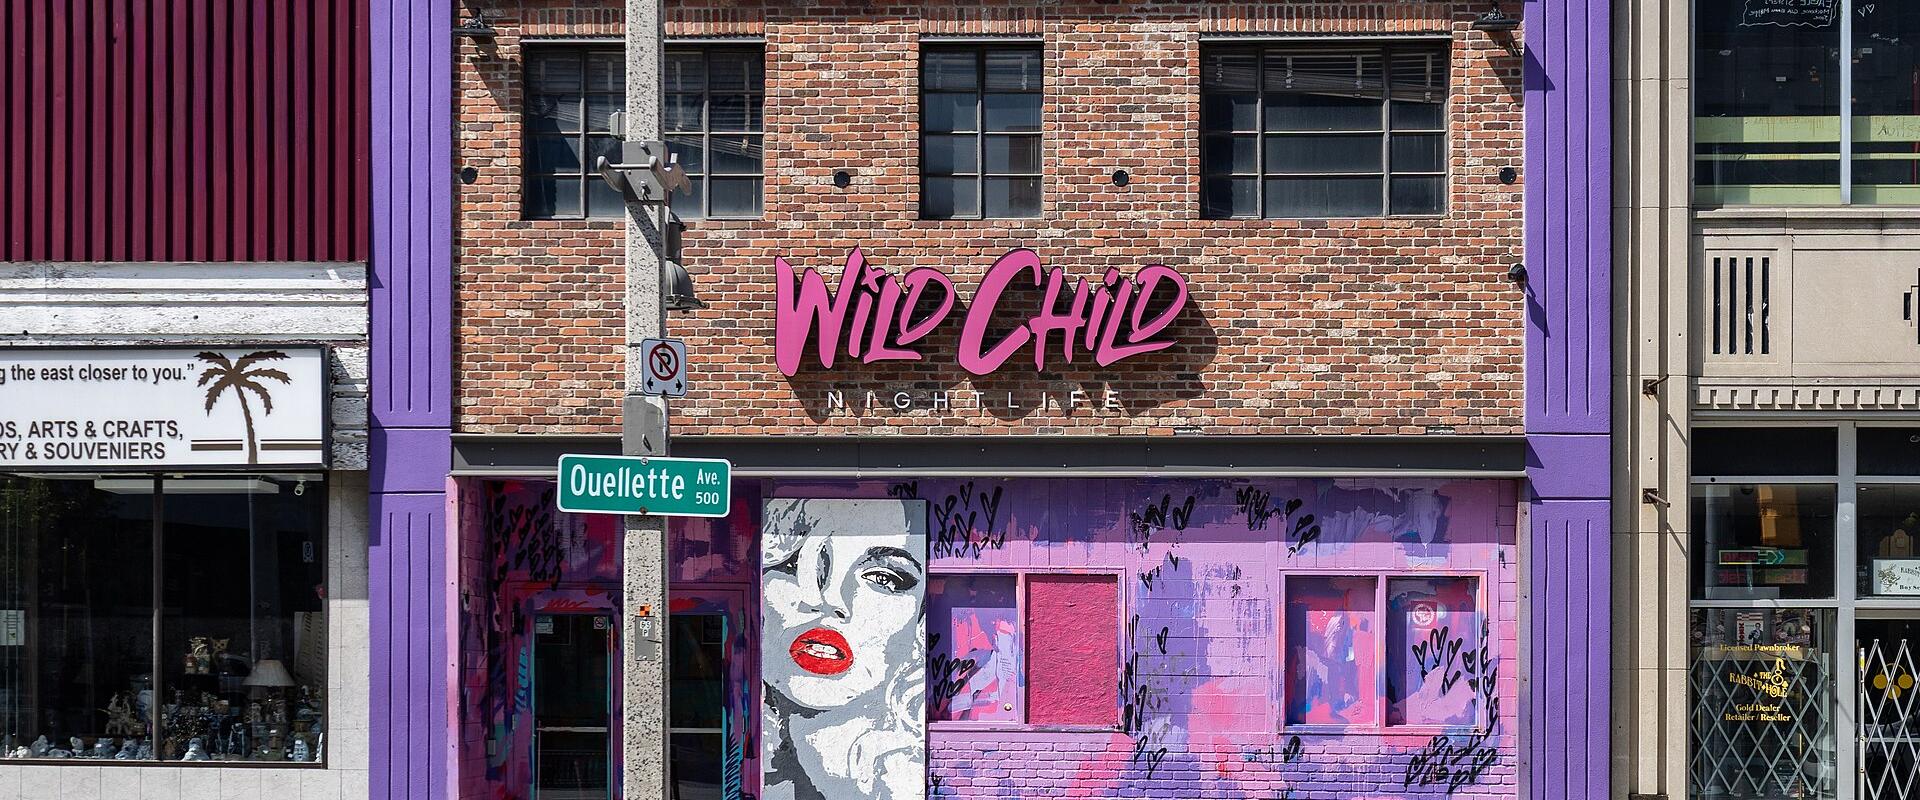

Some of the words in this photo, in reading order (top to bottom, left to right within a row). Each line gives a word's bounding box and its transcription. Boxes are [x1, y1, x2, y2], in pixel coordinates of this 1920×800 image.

[11, 363, 36, 381] the
[40, 364, 74, 381] east
[78, 363, 128, 381] closer
[132, 364, 148, 381] to
[827, 391, 1121, 409] NIGHTLIFE
[28, 420, 78, 438] ARTS
[84, 420, 97, 438] &
[103, 420, 183, 441] CRAFTS,
[25, 442, 38, 460] &
[43, 441, 165, 460] SOUVENIERS
[570, 463, 685, 500] Ouellette
[696, 468, 721, 486] Ave.
[695, 492, 720, 505] 500
[1759, 671, 1772, 680] THE
[1729, 672, 1762, 690] RABBIT
[1765, 682, 1788, 698] HOLE
[1735, 703, 1754, 711] Gold
[1755, 704, 1780, 712] Dealer
[1725, 713, 1755, 721] Retailer
[1760, 713, 1791, 721] Reseller
